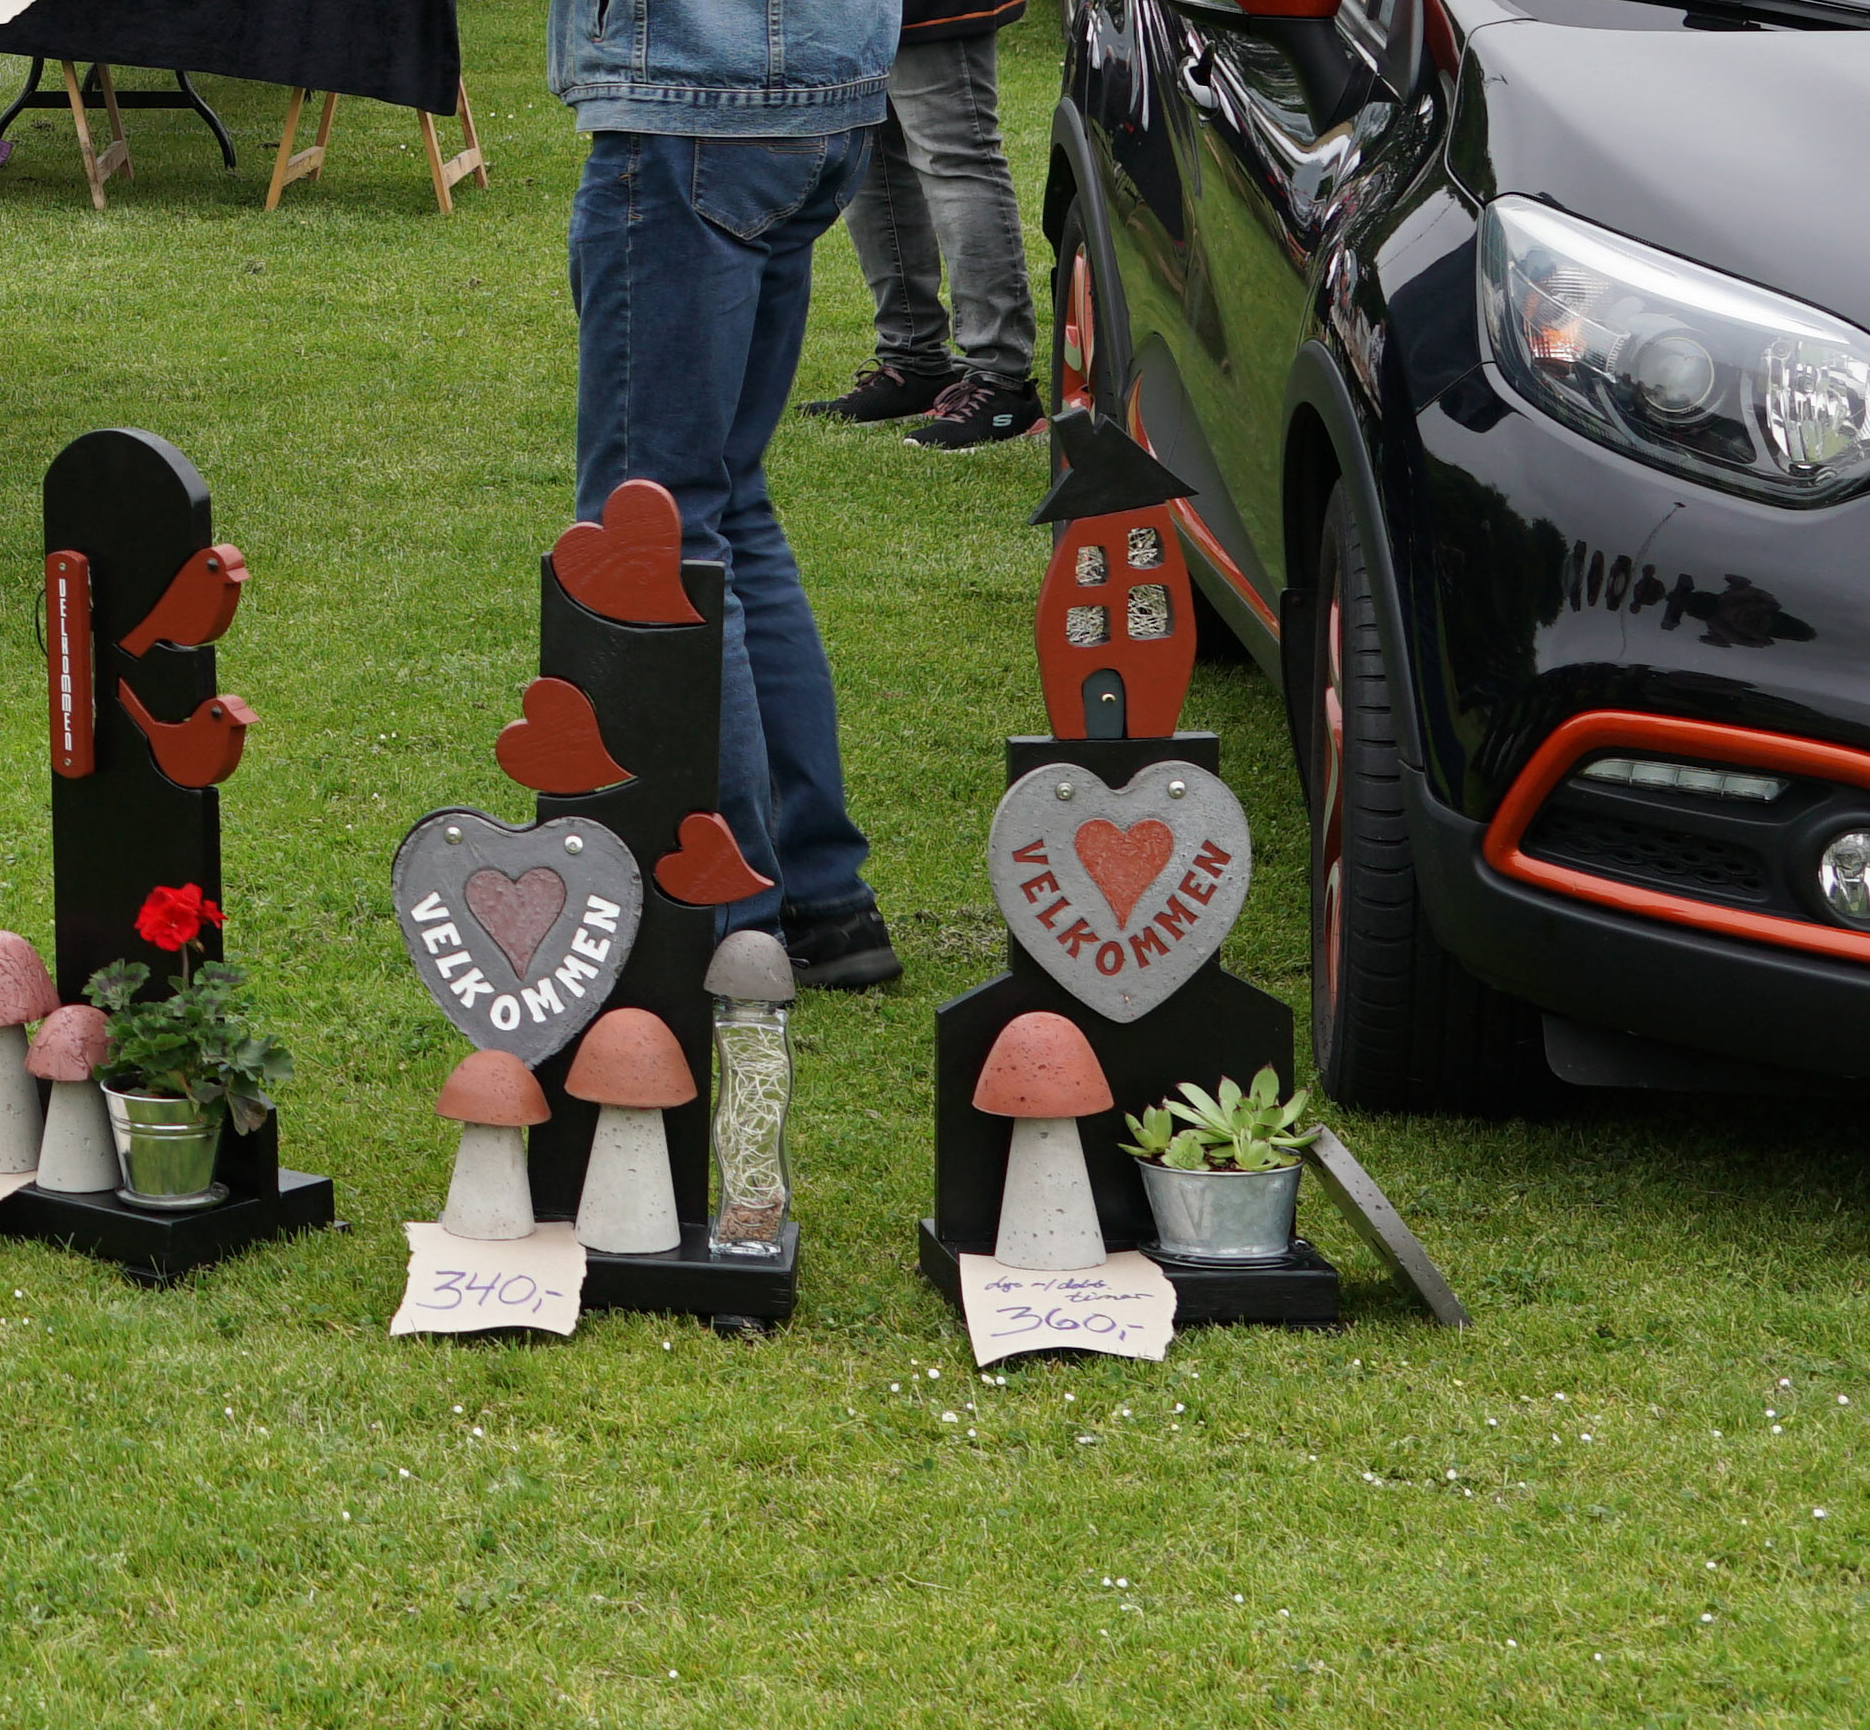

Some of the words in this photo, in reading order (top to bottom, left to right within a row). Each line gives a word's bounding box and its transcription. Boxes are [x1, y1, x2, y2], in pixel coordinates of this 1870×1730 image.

[1011, 838, 1233, 976] VELKOMMEN
[411, 891, 621, 1031] VELKOMMEN
[416, 1270, 564, 1314] 340,-
[990, 1306, 1145, 1342] 360,-
